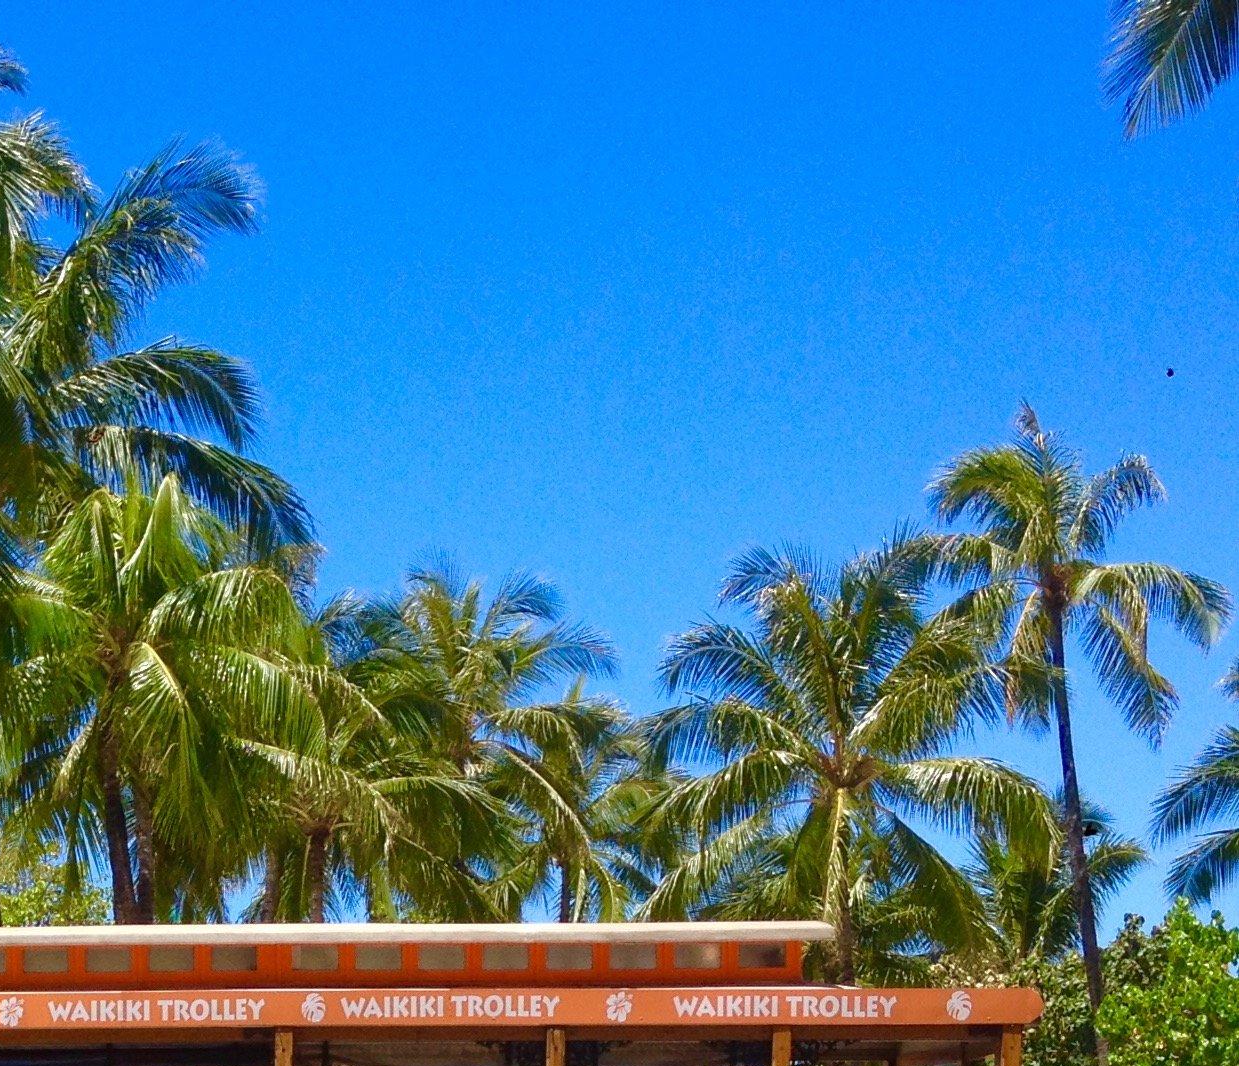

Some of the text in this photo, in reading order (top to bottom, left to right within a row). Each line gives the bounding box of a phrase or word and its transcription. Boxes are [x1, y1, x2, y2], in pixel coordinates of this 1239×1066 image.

[48, 998, 265, 1023] WAIKIKI TROLLEY
[340, 995, 560, 1019] WAIKIKI TROLLEY
[673, 995, 897, 1018] WAIKIKI TROLLEY
